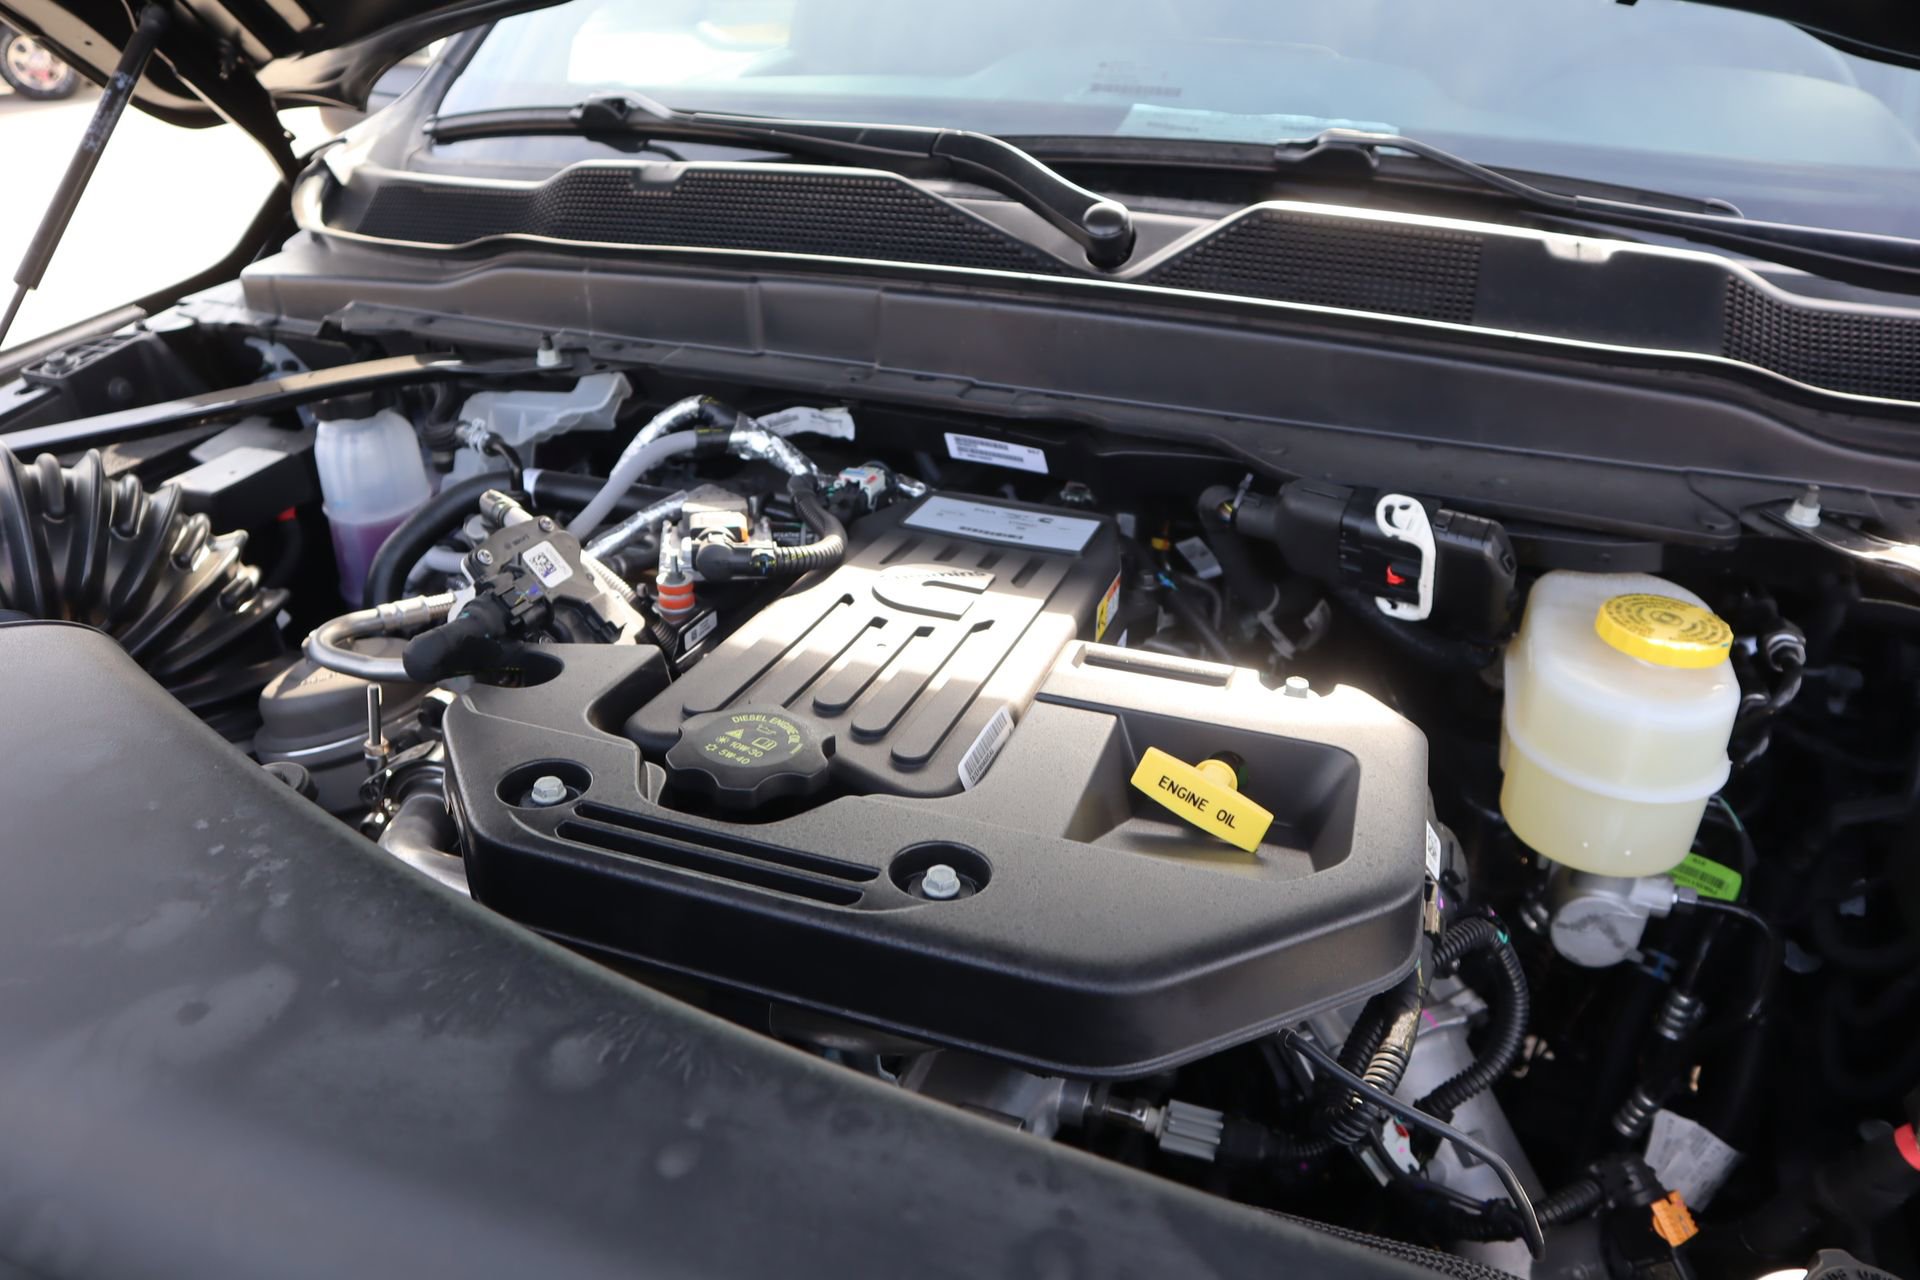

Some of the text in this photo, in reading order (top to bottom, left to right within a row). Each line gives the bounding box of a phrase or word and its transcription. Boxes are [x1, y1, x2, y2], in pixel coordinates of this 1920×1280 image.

[731, 714, 767, 723] DIESEL
[718, 749, 751, 765] 5W-40
[729, 741, 764, 758] 10W-30
[1157, 775, 1236, 829] ENGINE OIL
